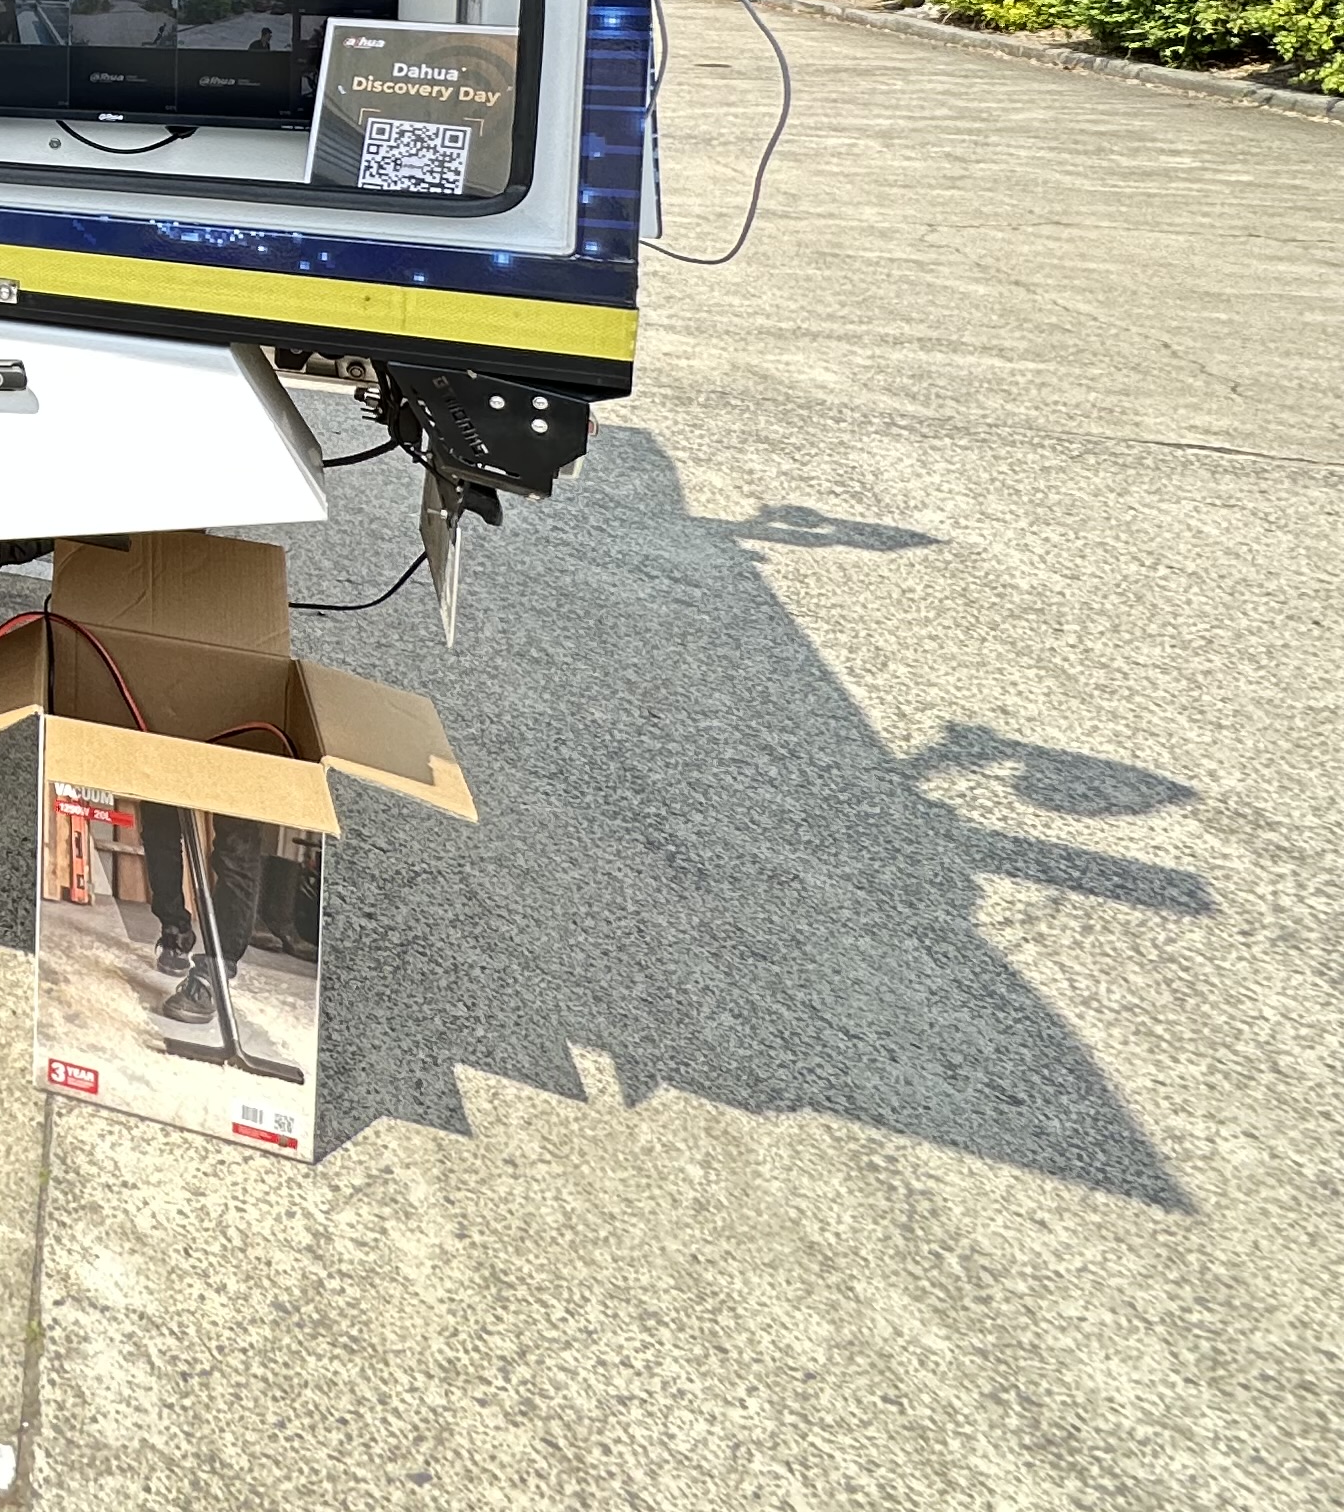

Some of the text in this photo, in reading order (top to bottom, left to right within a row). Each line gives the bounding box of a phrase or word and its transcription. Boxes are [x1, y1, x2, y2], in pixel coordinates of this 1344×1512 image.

[392, 61, 460, 82] Dahua
[351, 75, 502, 107] Discovery Day
[54, 781, 114, 806] VACUUM
[50, 1061, 66, 1083] 3
[67, 1066, 96, 1083] YEAR
